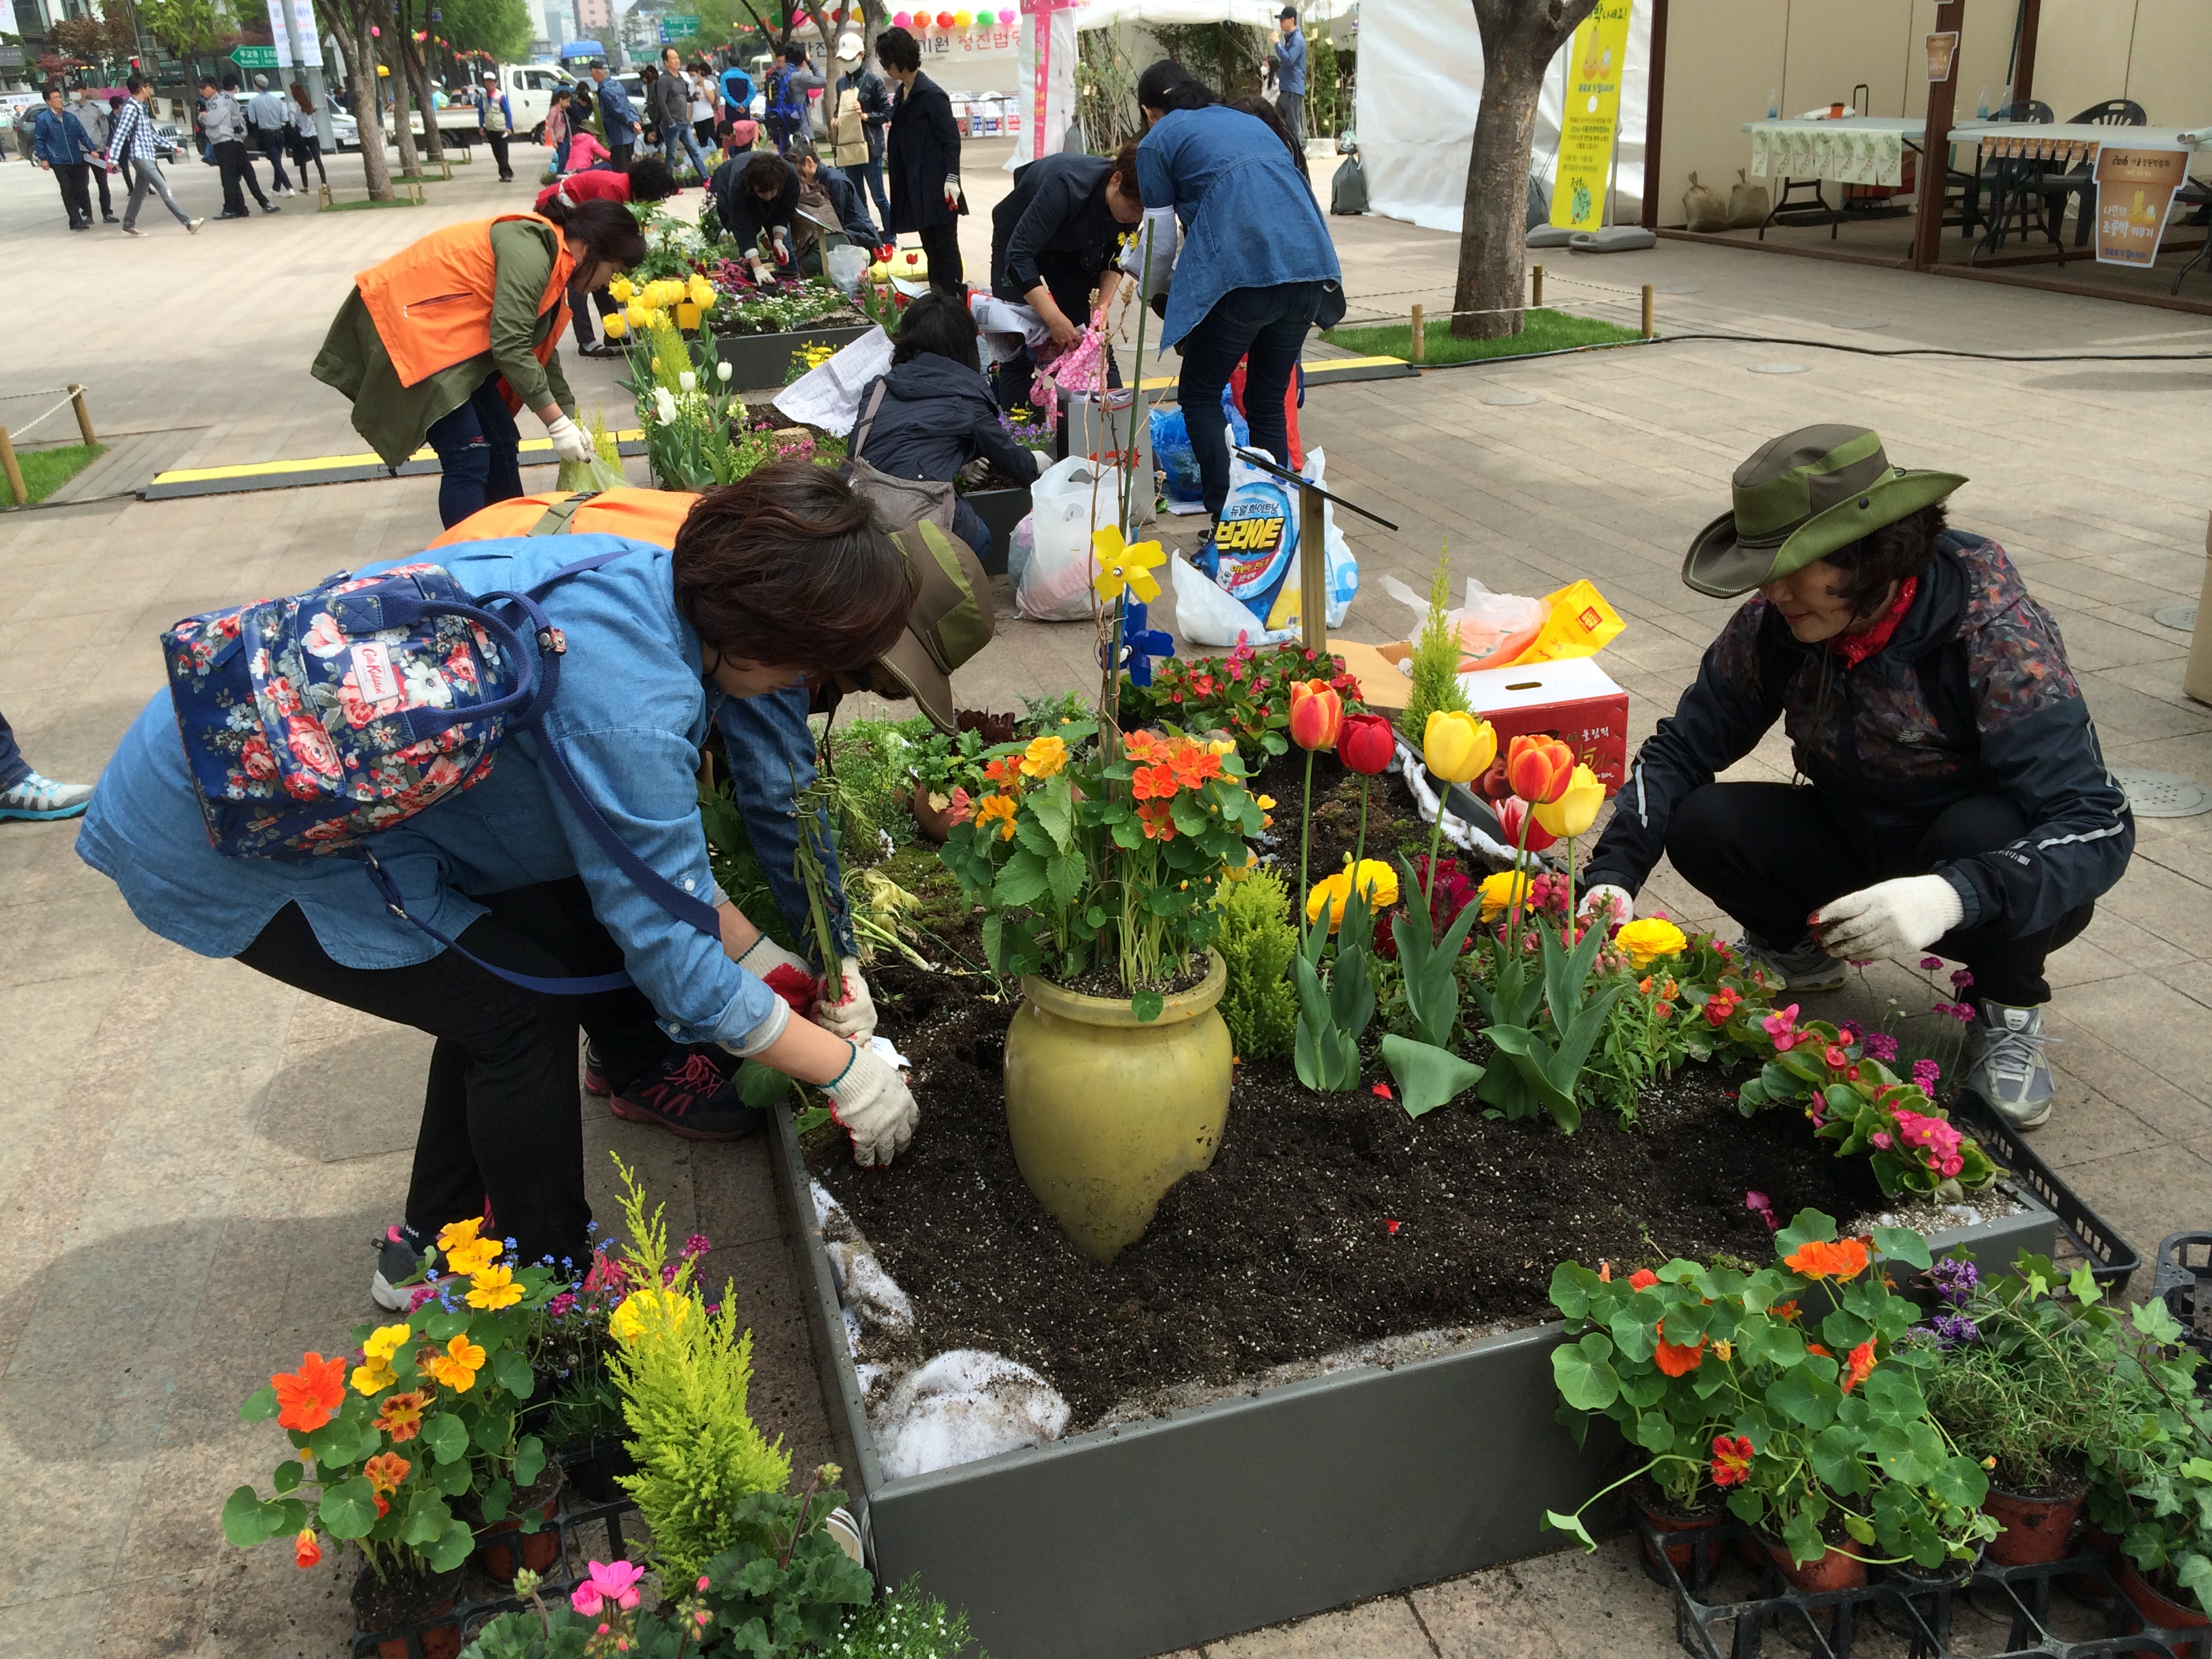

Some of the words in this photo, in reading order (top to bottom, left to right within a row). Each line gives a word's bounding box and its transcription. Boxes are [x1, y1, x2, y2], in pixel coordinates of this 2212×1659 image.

[2112, 155, 2128, 165] 2016
[2104, 205, 2127, 217] 나만의
[2102, 220, 2129, 237] 조롱박
[2131, 226, 2154, 239] 키우기
[1231, 504, 1248, 516] 듀얼
[1248, 502, 1279, 514] 화이트닝
[1215, 517, 1285, 550] 브라이트
[362, 649, 377, 664] Cath
[366, 665, 382, 694] Kidston
